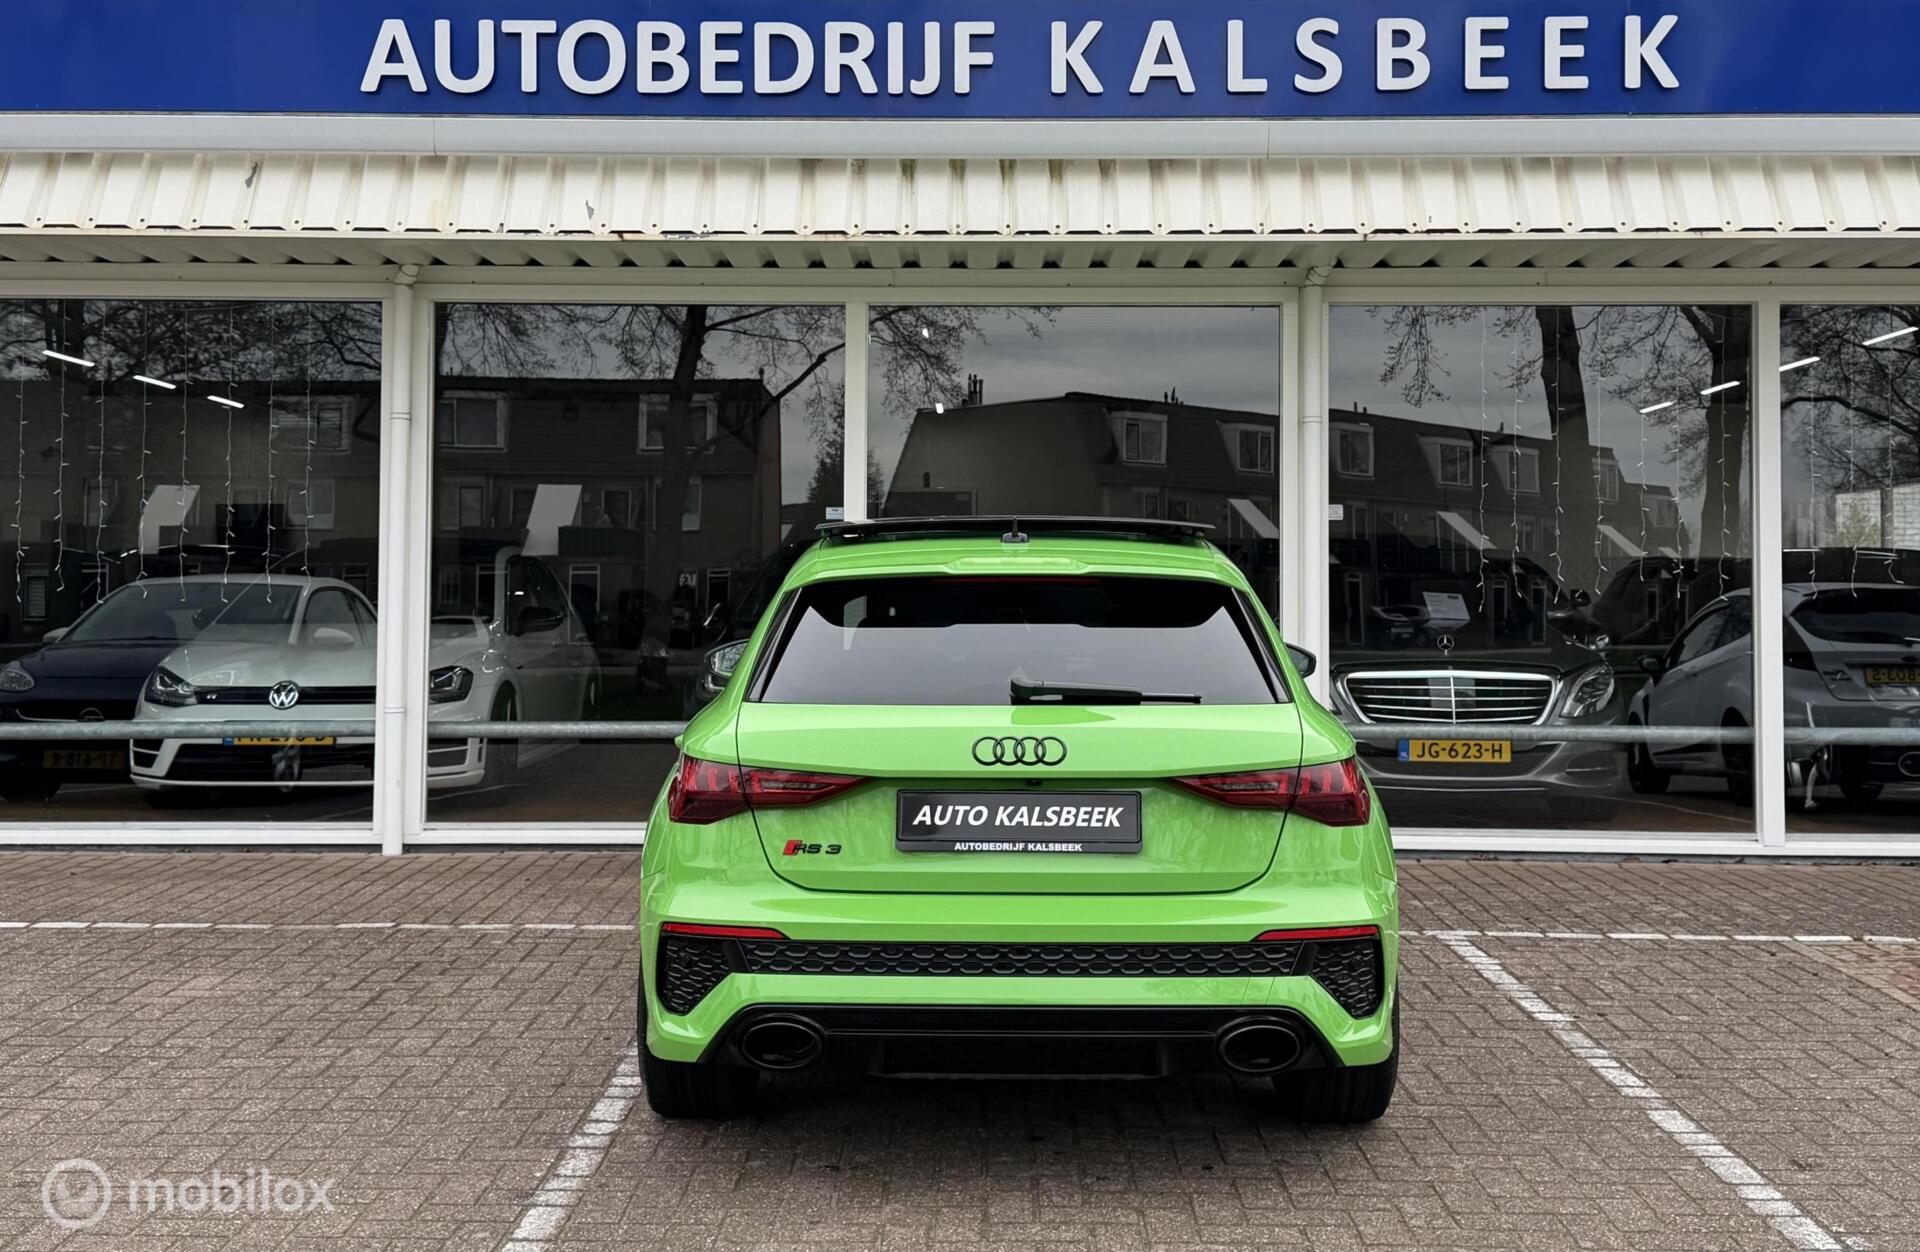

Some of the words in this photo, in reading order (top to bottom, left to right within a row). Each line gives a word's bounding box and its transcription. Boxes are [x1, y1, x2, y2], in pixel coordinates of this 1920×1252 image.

[361, 17, 996, 96] AUTOBEDRIJF
[1050, 14, 1681, 95] KALSBEEK
[1416, 742, 1502, 760] JG-623-H
[912, 805, 988, 826] AUTO
[994, 805, 1124, 828] KALSBEEK
[788, 842, 823, 856] RS
[825, 843, 842, 855] 3
[954, 842, 1025, 851] AUTOBEDRIJF
[1027, 843, 1082, 852] KALSBEEK
